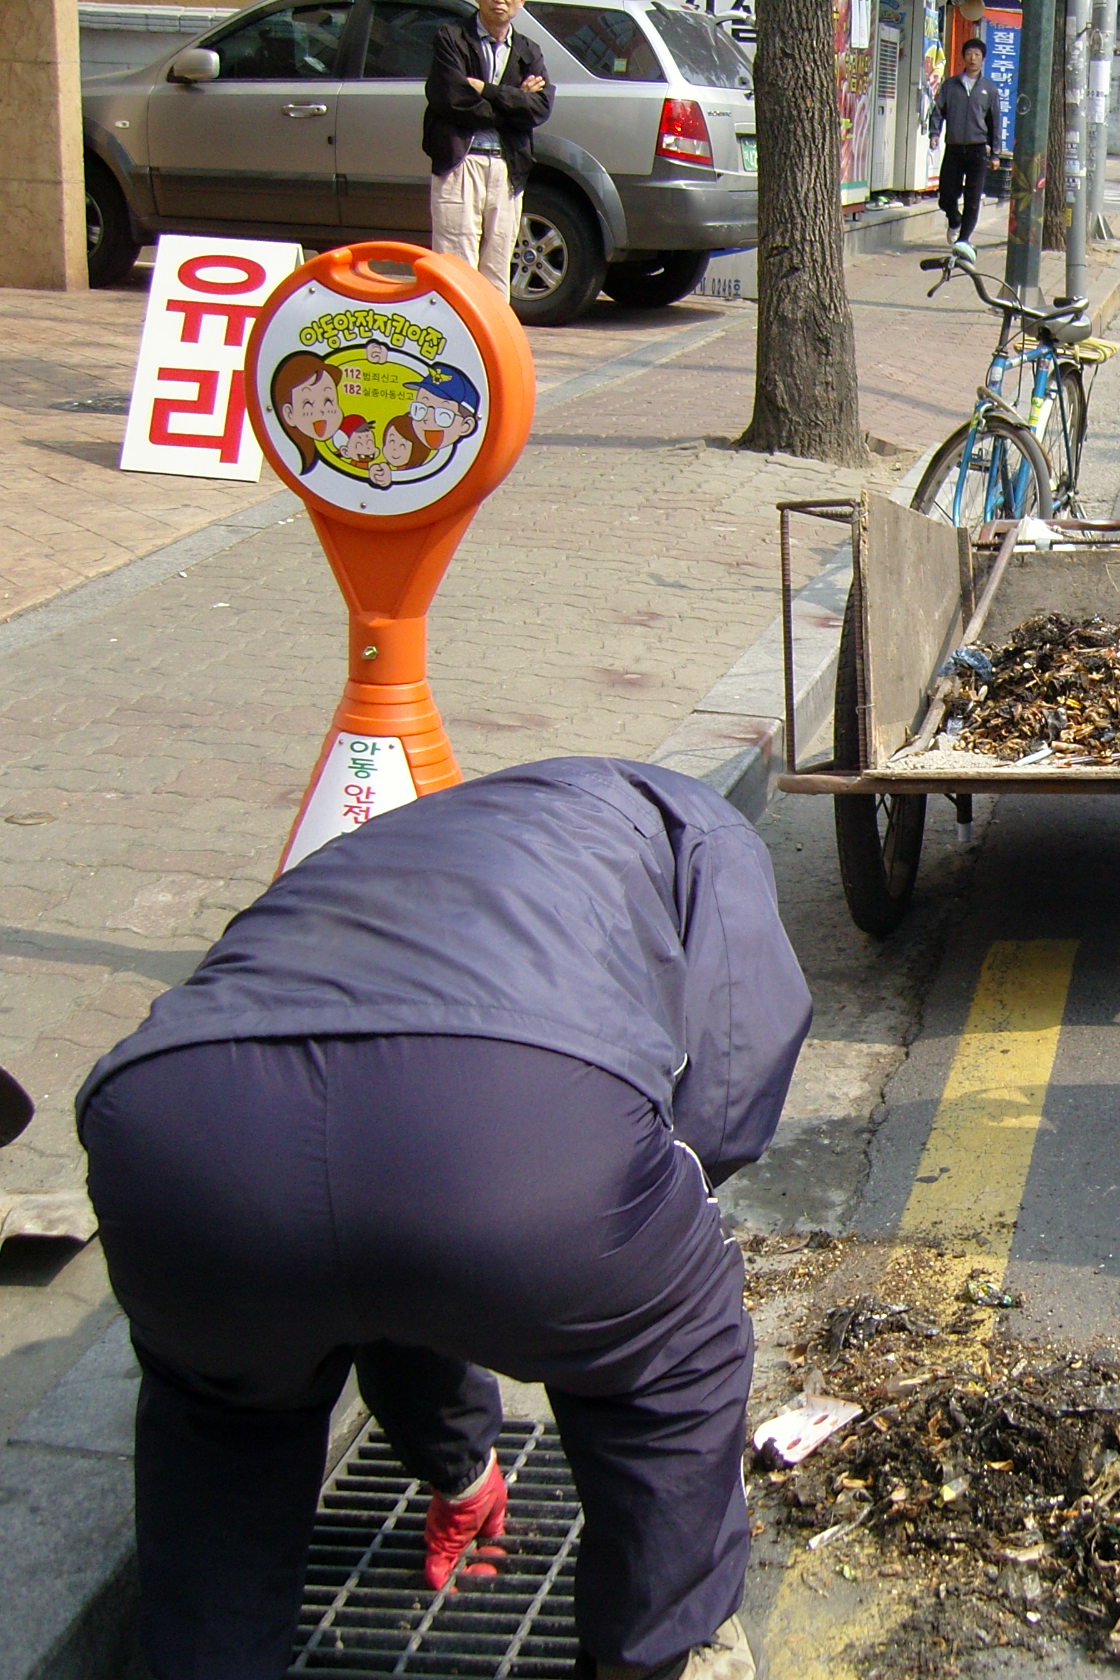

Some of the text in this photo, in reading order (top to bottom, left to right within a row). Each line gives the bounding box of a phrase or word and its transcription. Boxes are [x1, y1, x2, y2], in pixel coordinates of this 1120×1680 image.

[148, 254, 267, 465] 유리
[298, 309, 448, 360] 아동안전지킴이집
[343, 368, 399, 383] 112 범죄신고
[343, 383, 415, 401] 182 실종아동신고
[342, 740, 382, 825] 아동 안전
